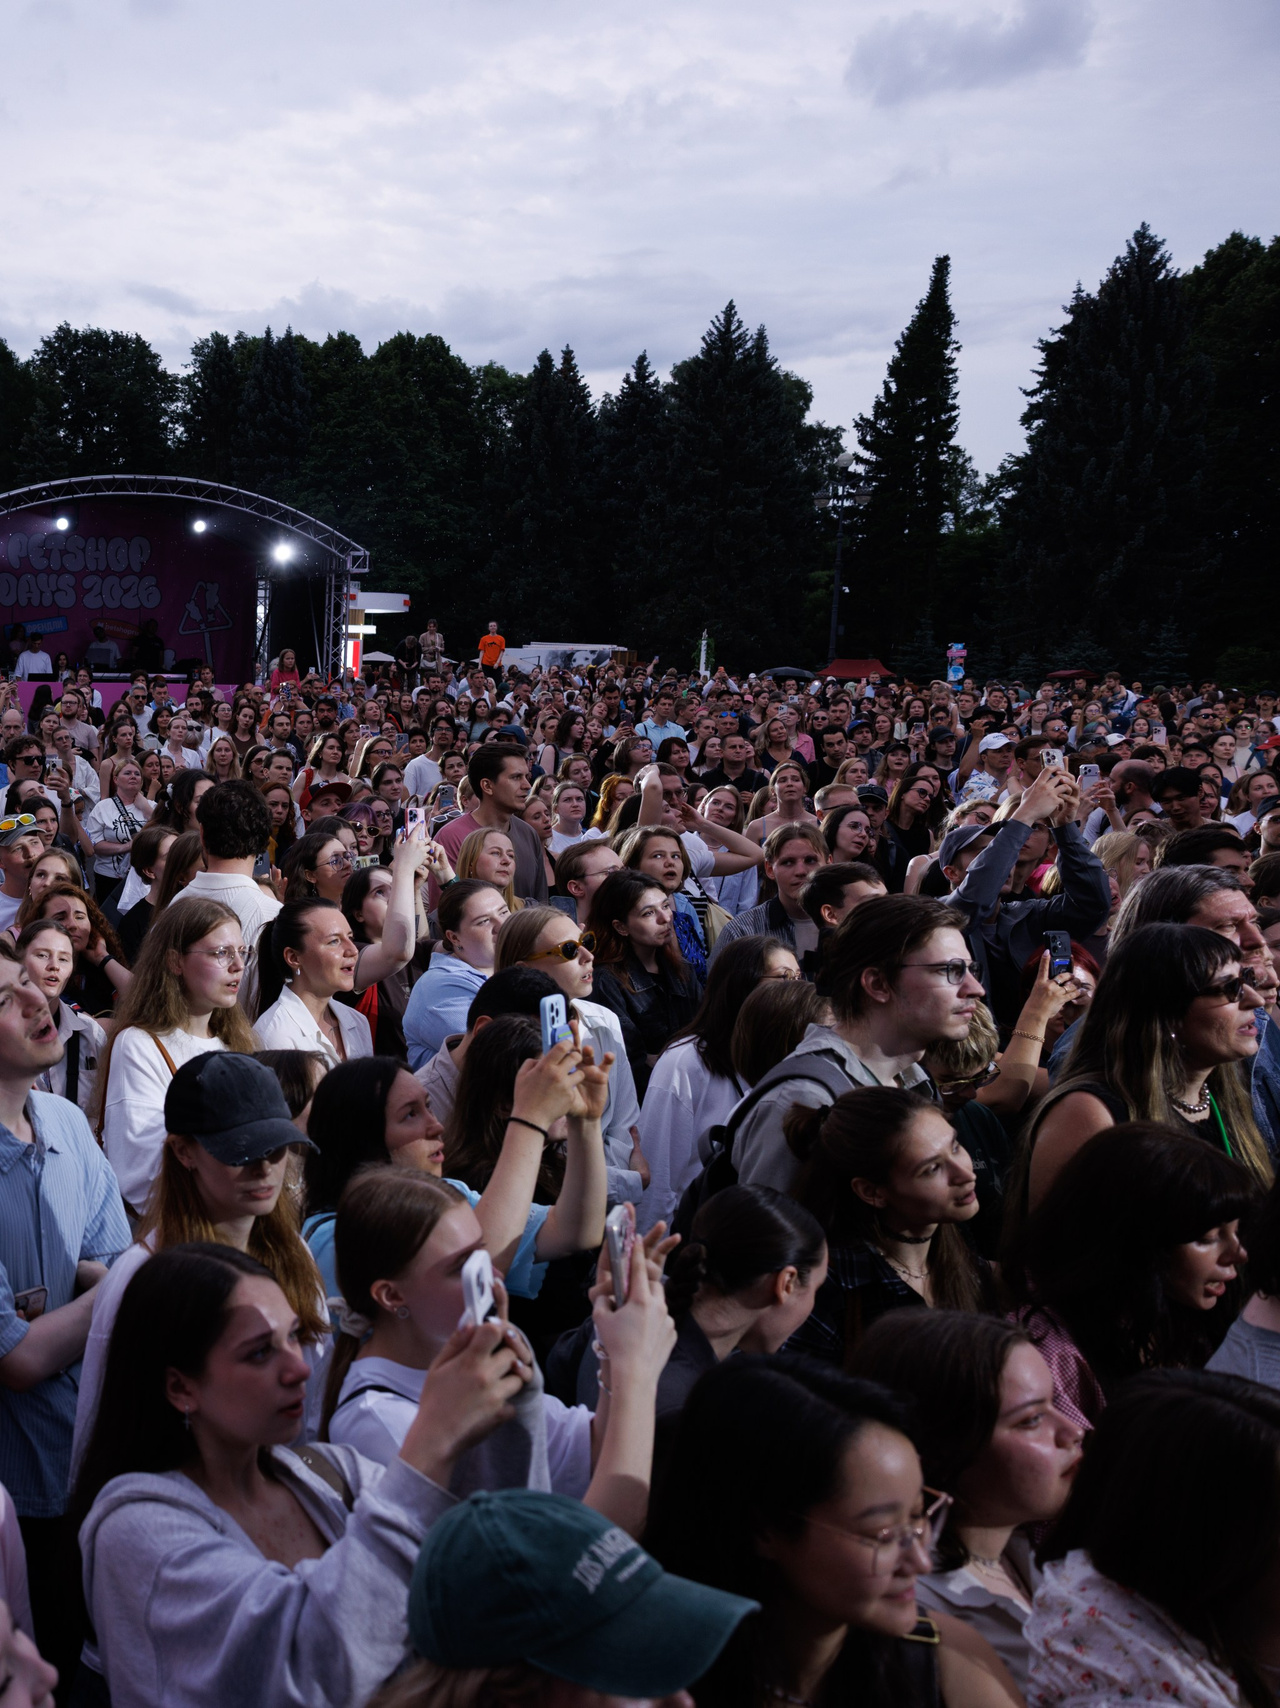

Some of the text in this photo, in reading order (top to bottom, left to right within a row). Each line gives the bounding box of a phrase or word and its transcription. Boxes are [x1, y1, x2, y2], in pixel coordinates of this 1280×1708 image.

[7, 532, 152, 573] PETSHOP
[81, 573, 162, 610] 2026
[572, 1550, 605, 1595] LOS
